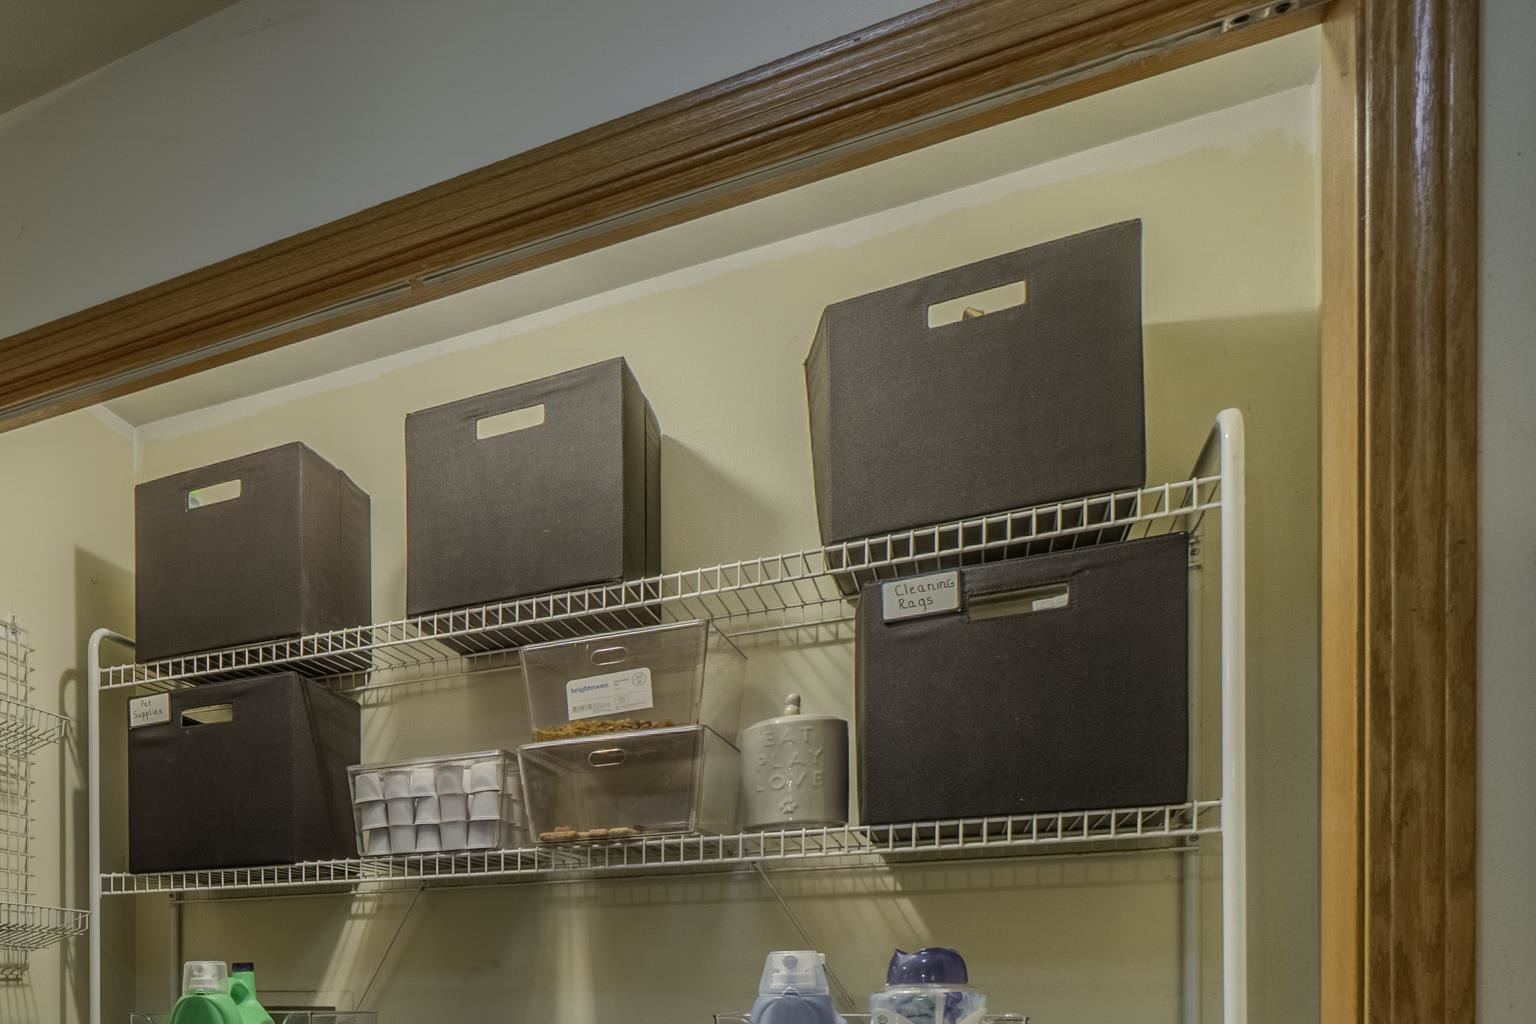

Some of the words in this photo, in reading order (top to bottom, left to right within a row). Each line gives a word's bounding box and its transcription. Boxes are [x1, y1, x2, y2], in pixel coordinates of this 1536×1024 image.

[898, 596, 933, 612] Rags
[140, 698, 152, 707] Pet
[133, 708, 163, 721] Supplies
[762, 726, 813, 748] EAT
[755, 771, 825, 793] LOVE
